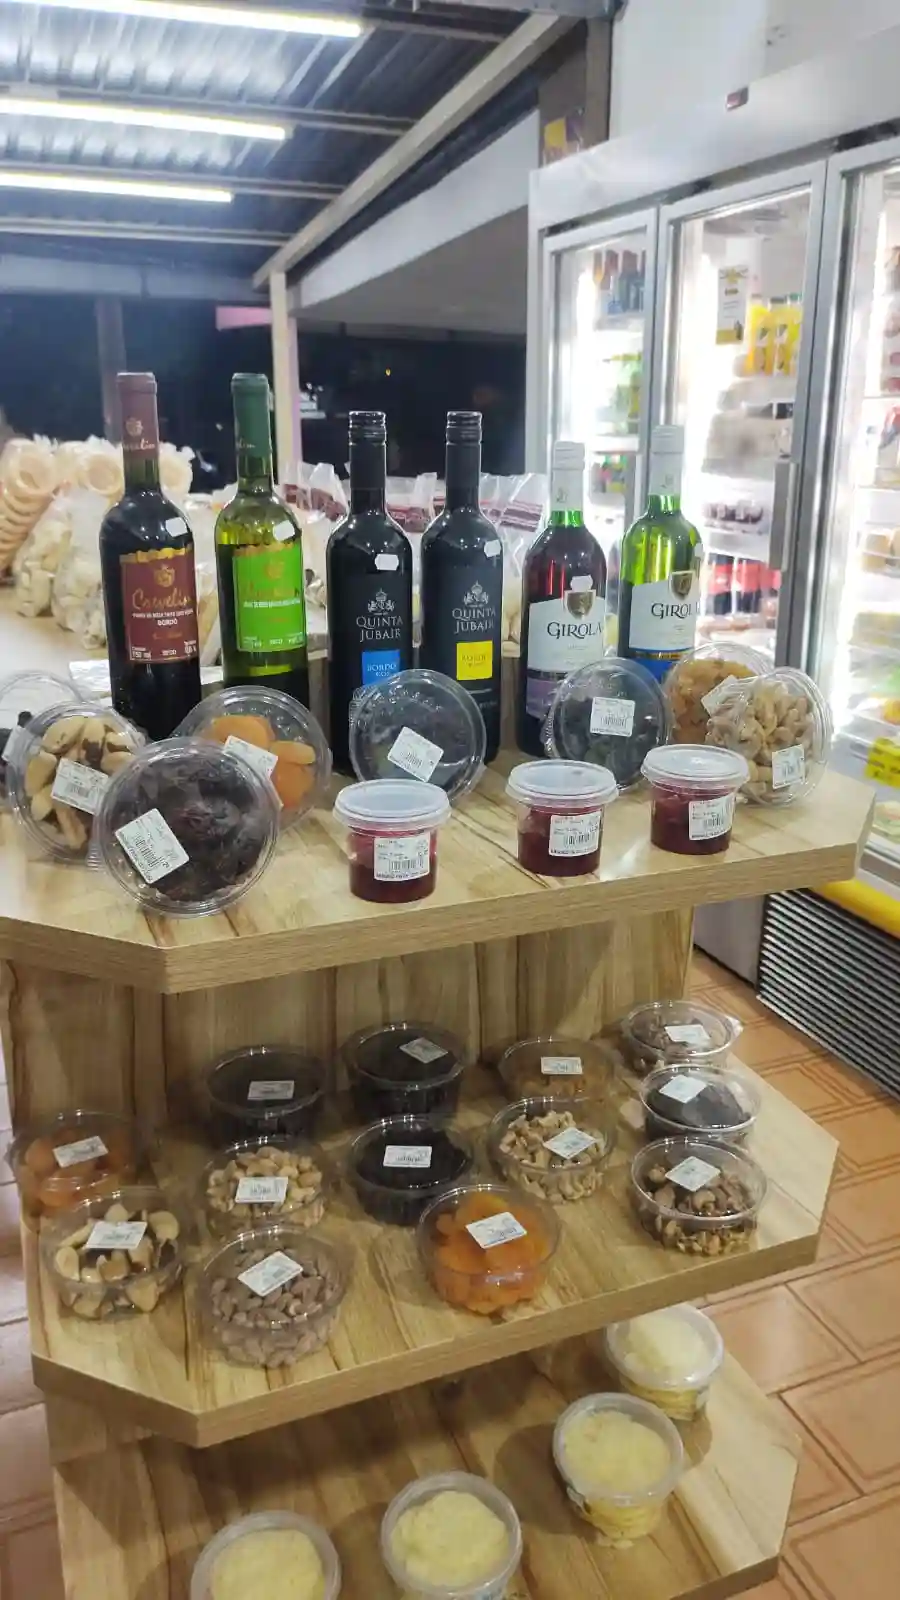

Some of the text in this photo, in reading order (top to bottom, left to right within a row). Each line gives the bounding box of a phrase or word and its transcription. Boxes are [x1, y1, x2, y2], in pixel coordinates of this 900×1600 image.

[452, 607, 496, 622] QUINTA
[356, 615, 403, 629] QUINTA
[360, 628, 401, 642] JUBAIR
